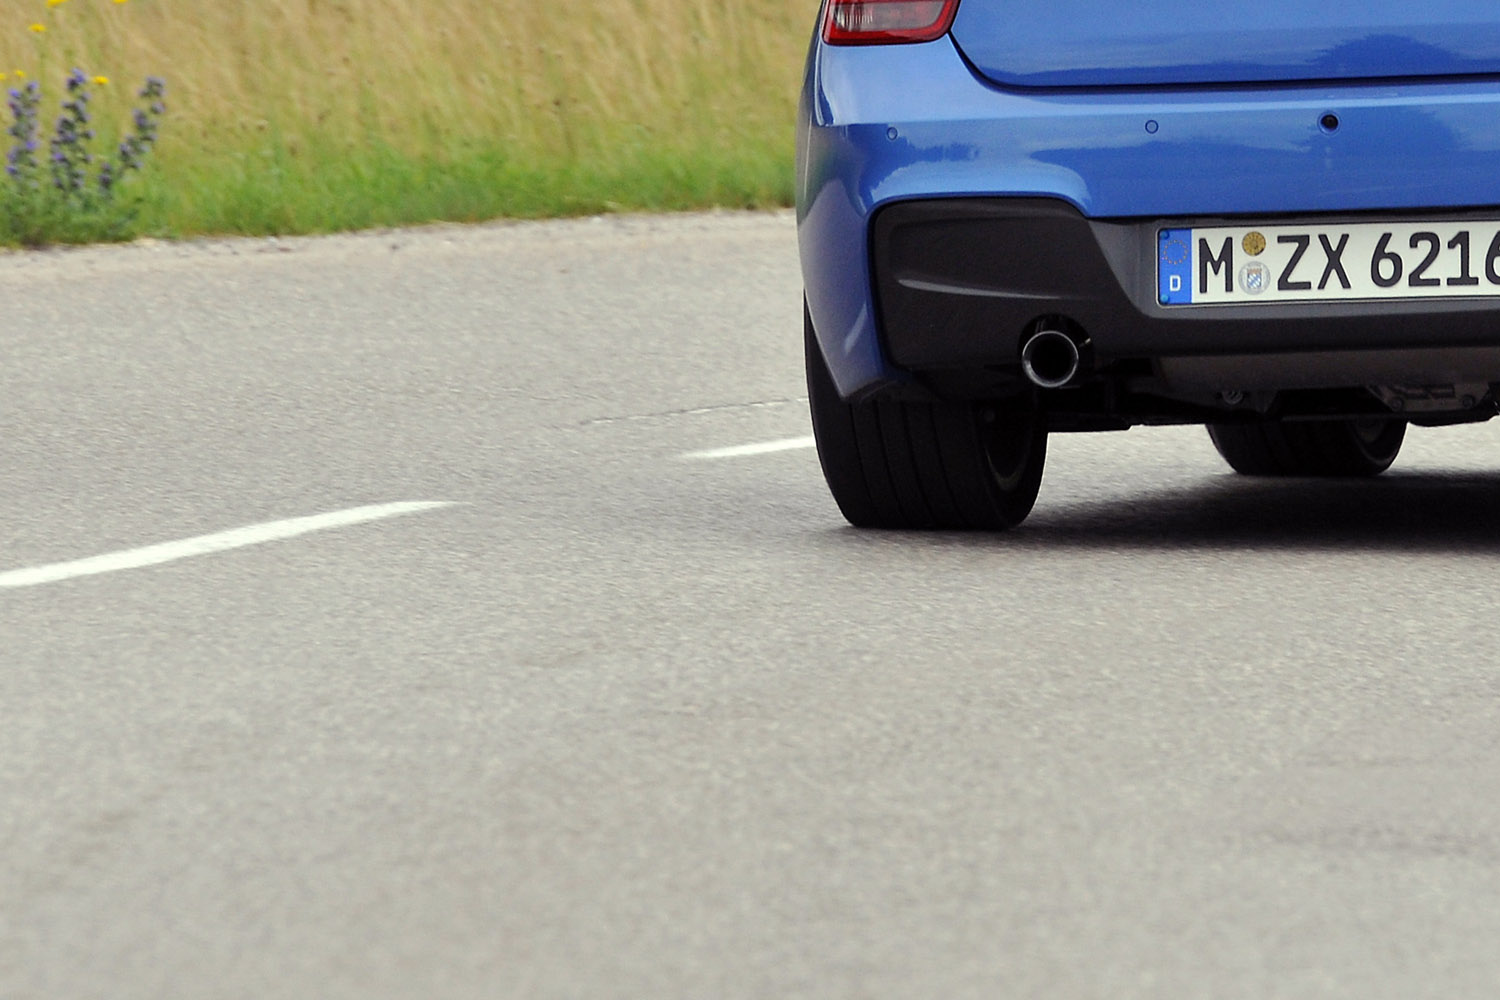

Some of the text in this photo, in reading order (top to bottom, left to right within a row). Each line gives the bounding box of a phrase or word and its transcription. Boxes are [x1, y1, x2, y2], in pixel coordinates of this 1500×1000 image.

[1169, 274, 1181, 292] D
[1199, 236, 1234, 294] M
[1276, 233, 1351, 291] ZX
